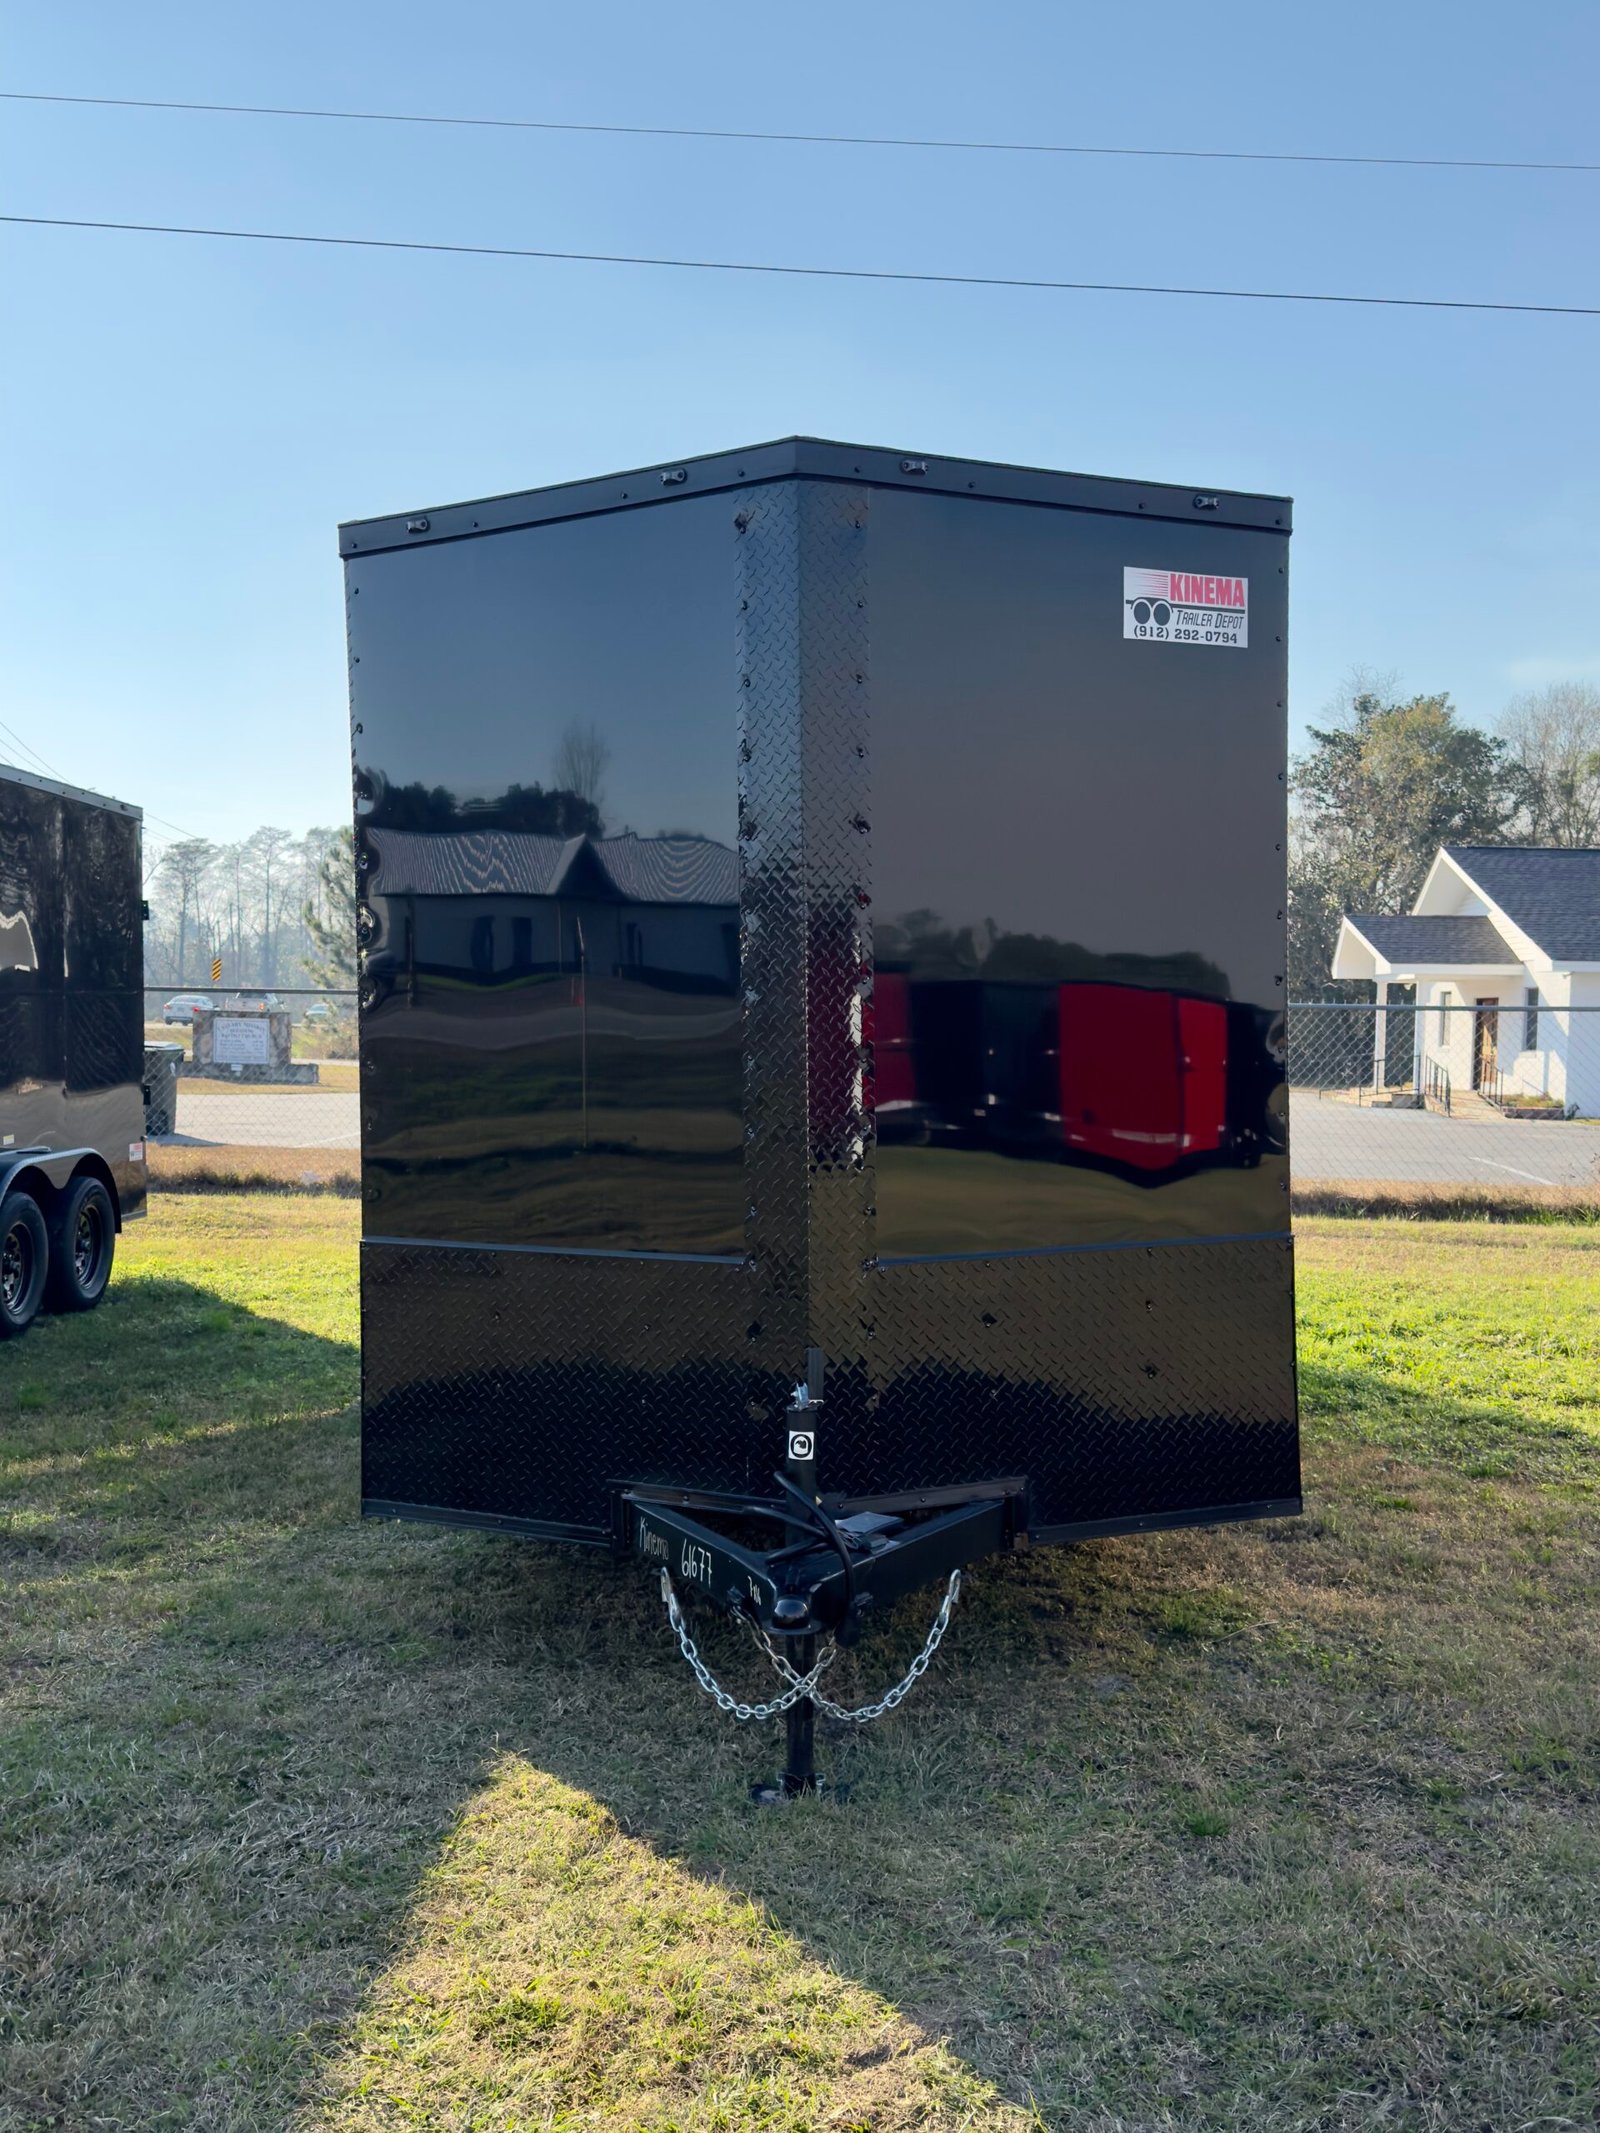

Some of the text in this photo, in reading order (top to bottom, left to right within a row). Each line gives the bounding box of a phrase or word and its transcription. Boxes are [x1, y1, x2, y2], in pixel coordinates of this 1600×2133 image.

[1169, 572, 1245, 608] KINEMA
[1175, 609, 1245, 630] TRAILER DEPOT
[1133, 624, 1238, 645] (912) 292-0794
[681, 1538, 713, 1589] 61677
